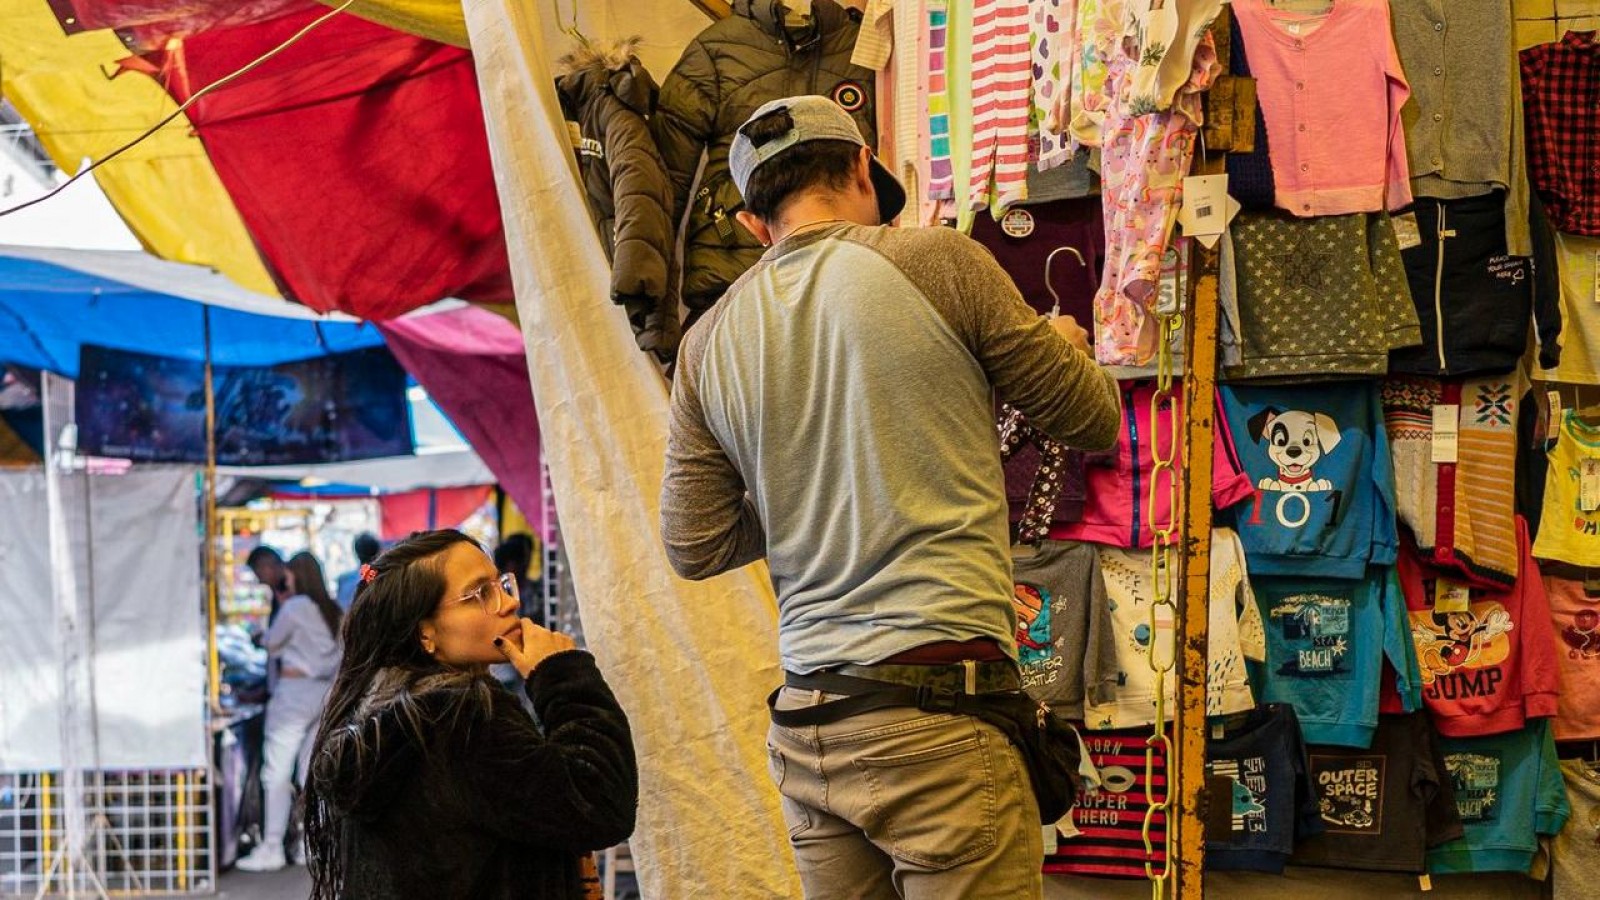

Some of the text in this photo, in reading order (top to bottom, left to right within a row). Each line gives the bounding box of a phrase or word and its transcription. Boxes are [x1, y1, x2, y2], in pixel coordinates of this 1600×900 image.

[1314, 634, 1335, 646] SEA
[1042, 655, 1064, 672] FOR
[1299, 649, 1332, 669] BEACH
[1021, 669, 1059, 690] BATTLE
[1426, 667, 1502, 699] JUMP
[1097, 755, 1105, 767] A
[1319, 768, 1378, 785] OUTER
[1325, 782, 1377, 799] SPACE
[1074, 793, 1128, 811] SUPER
[1456, 799, 1482, 817] EACH
[1079, 809, 1120, 826] HERO
